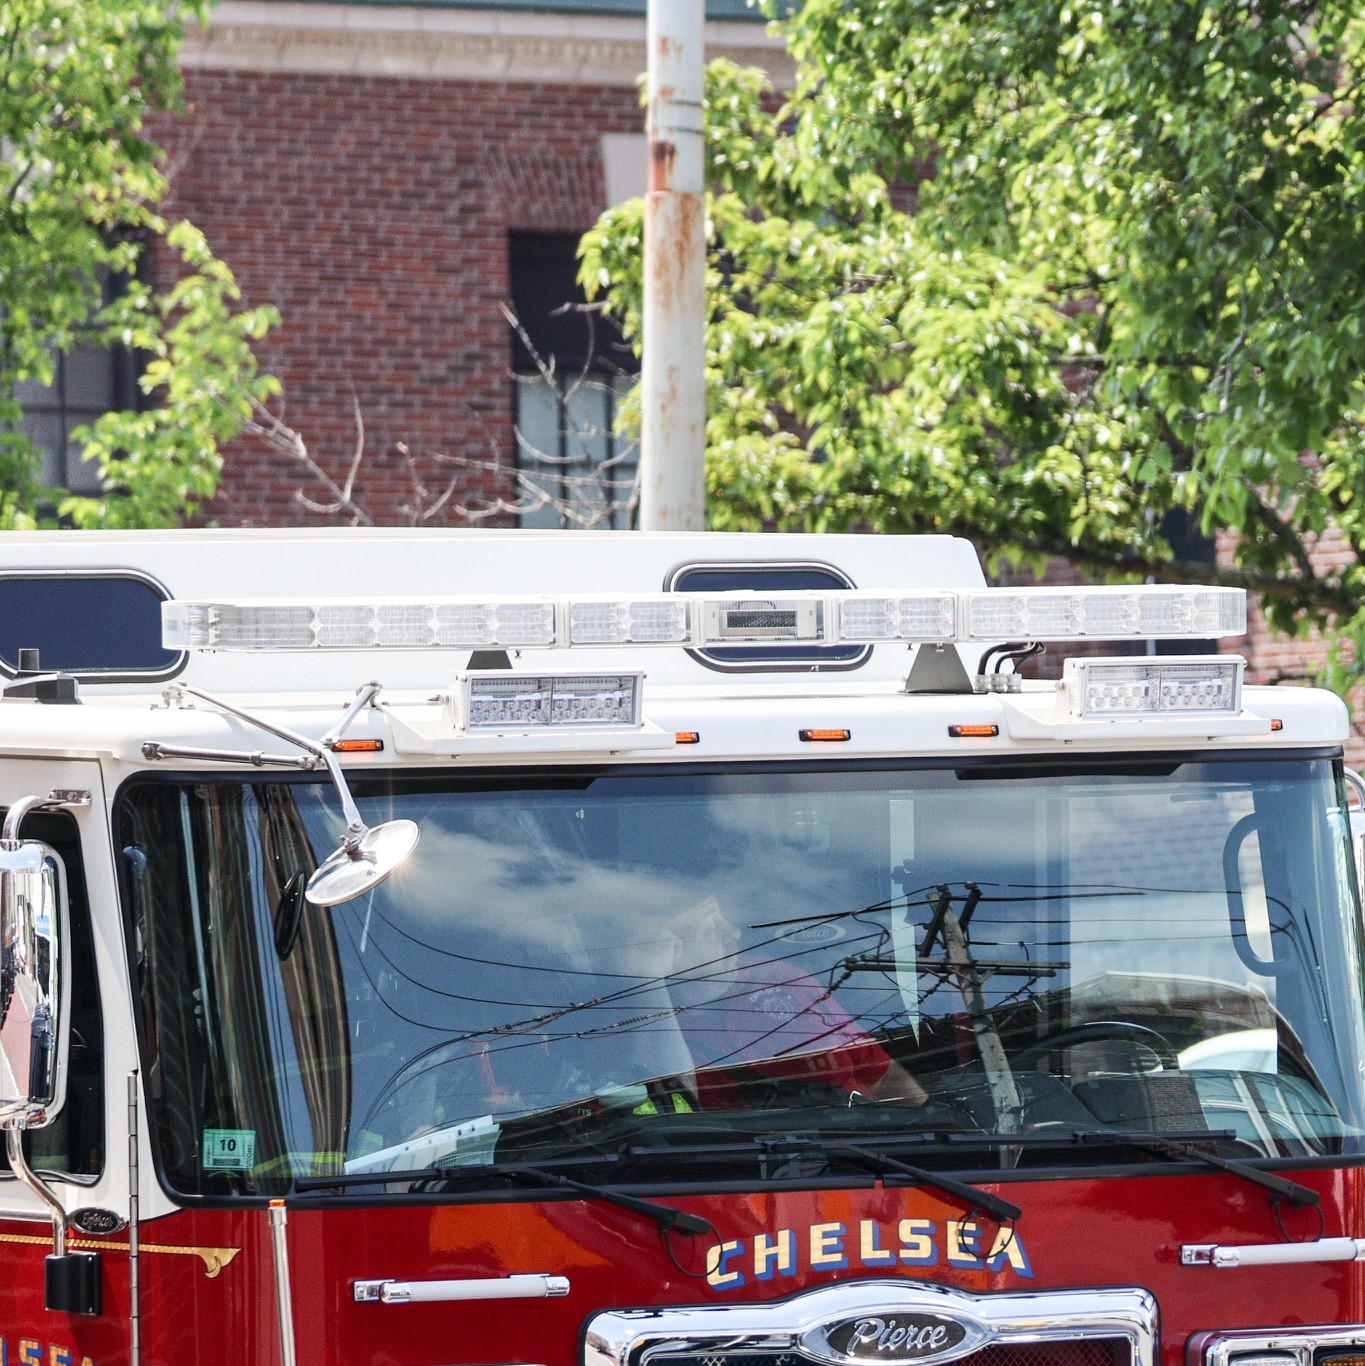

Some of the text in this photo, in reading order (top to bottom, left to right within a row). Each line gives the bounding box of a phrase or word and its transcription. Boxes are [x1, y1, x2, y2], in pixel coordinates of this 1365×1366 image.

[219, 1138, 237, 1152] 10
[705, 1218, 1034, 1290] CHELSEA
[846, 1316, 950, 1358] Pierce
